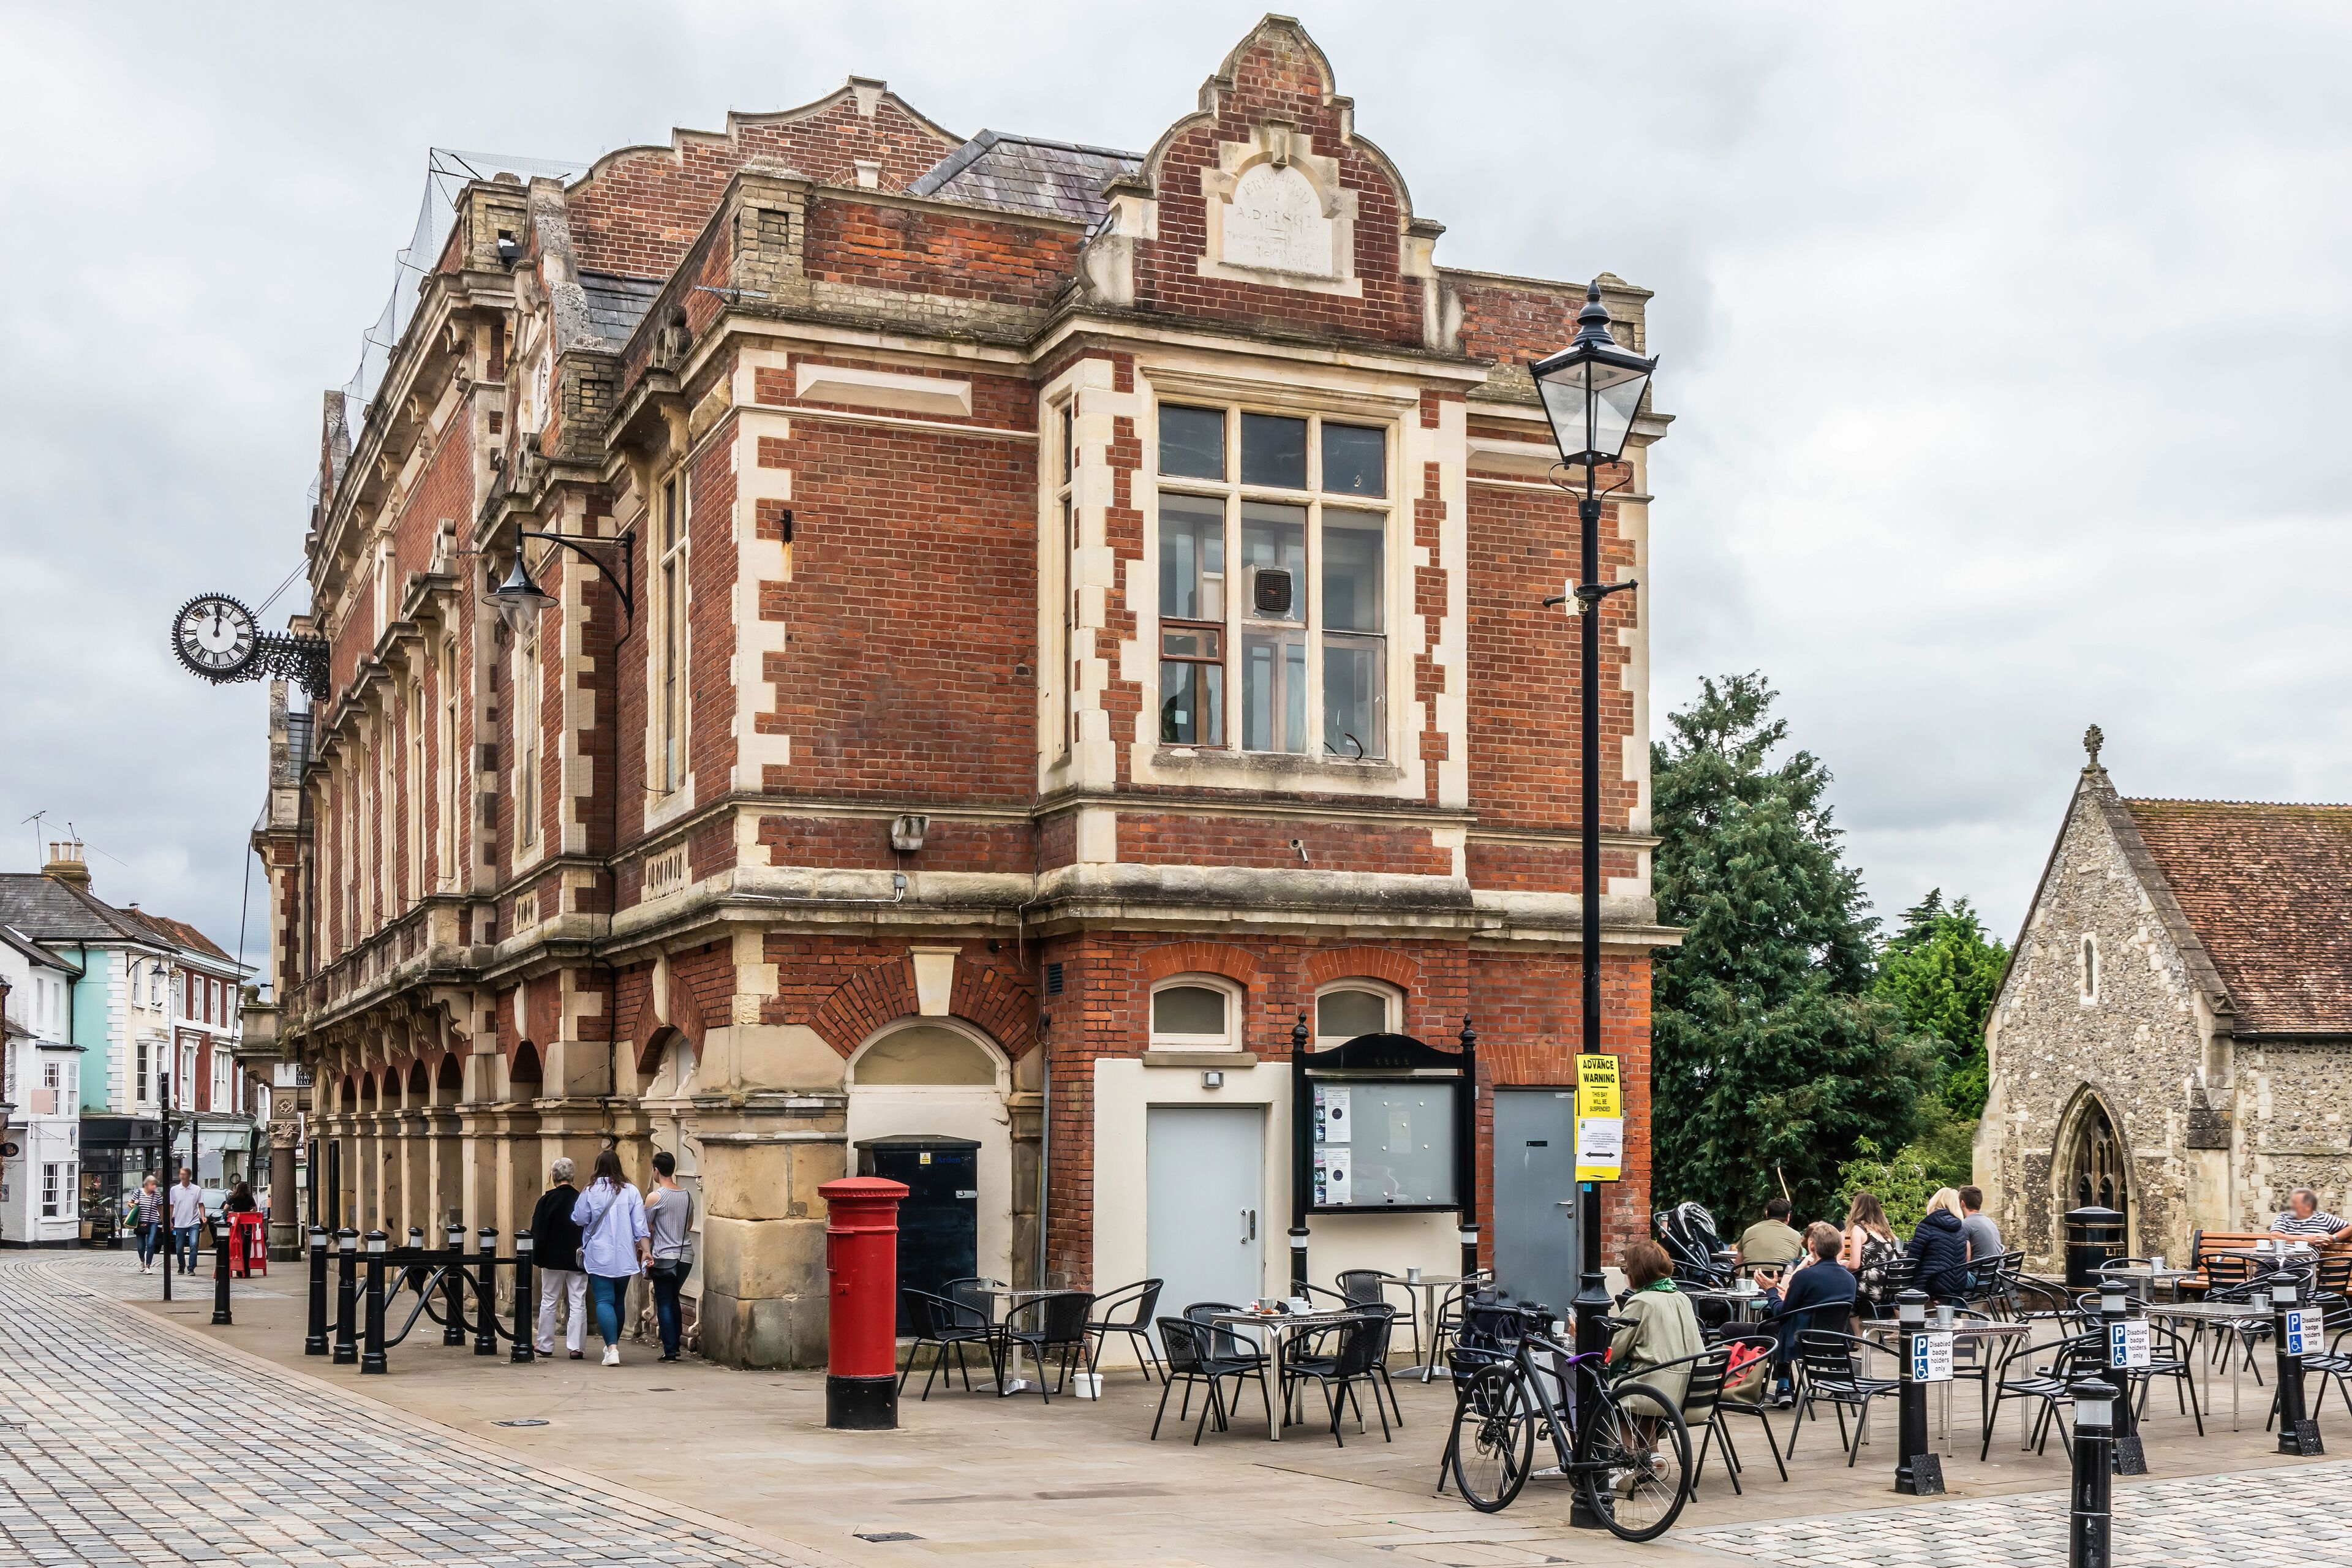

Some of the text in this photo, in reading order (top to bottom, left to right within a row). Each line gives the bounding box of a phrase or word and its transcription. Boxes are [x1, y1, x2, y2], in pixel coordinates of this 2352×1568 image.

[1583, 1060, 1614, 1069] ADVANCE
[1583, 1073, 1615, 1083] WARNING
[2291, 1315, 2299, 1331] P
[2115, 1327, 2124, 1343] P
[1917, 1338, 1926, 1355] P
